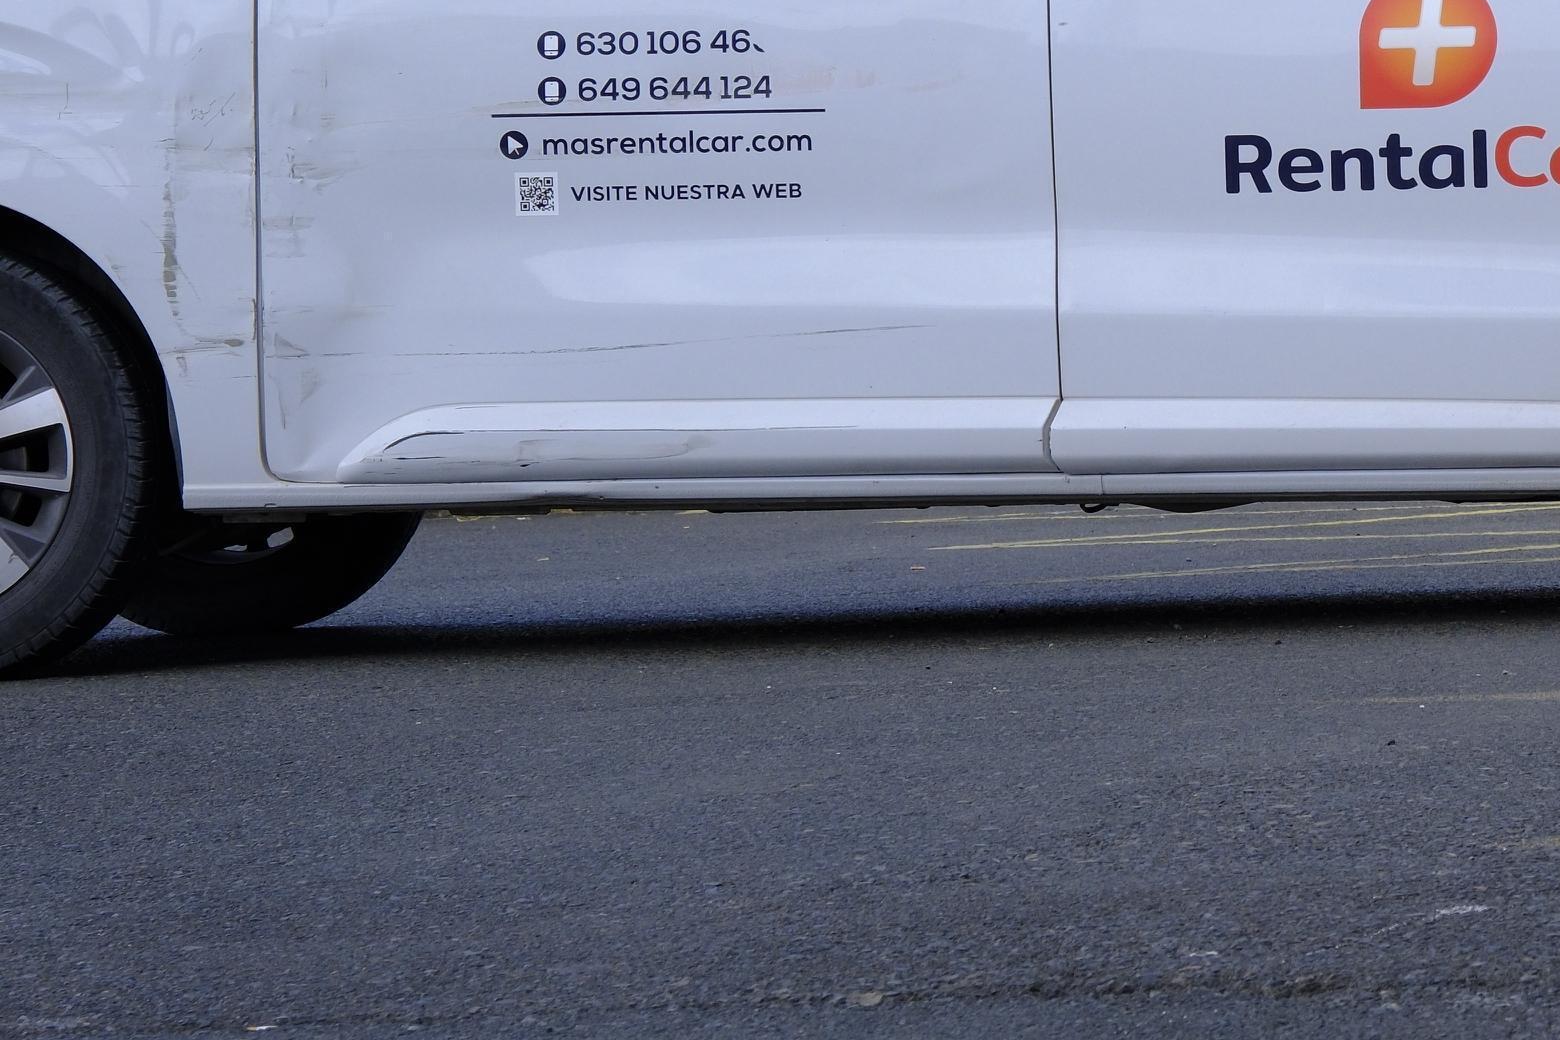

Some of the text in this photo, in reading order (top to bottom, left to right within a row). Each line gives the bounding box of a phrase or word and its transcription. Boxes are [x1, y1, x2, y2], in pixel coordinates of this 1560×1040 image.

[576, 29, 765, 56] 630 106 46
[578, 75, 773, 102] 649 644 124
[542, 129, 813, 156] masrentalcar.com
[570, 182, 803, 202] VISITE NUESTRA WEB
